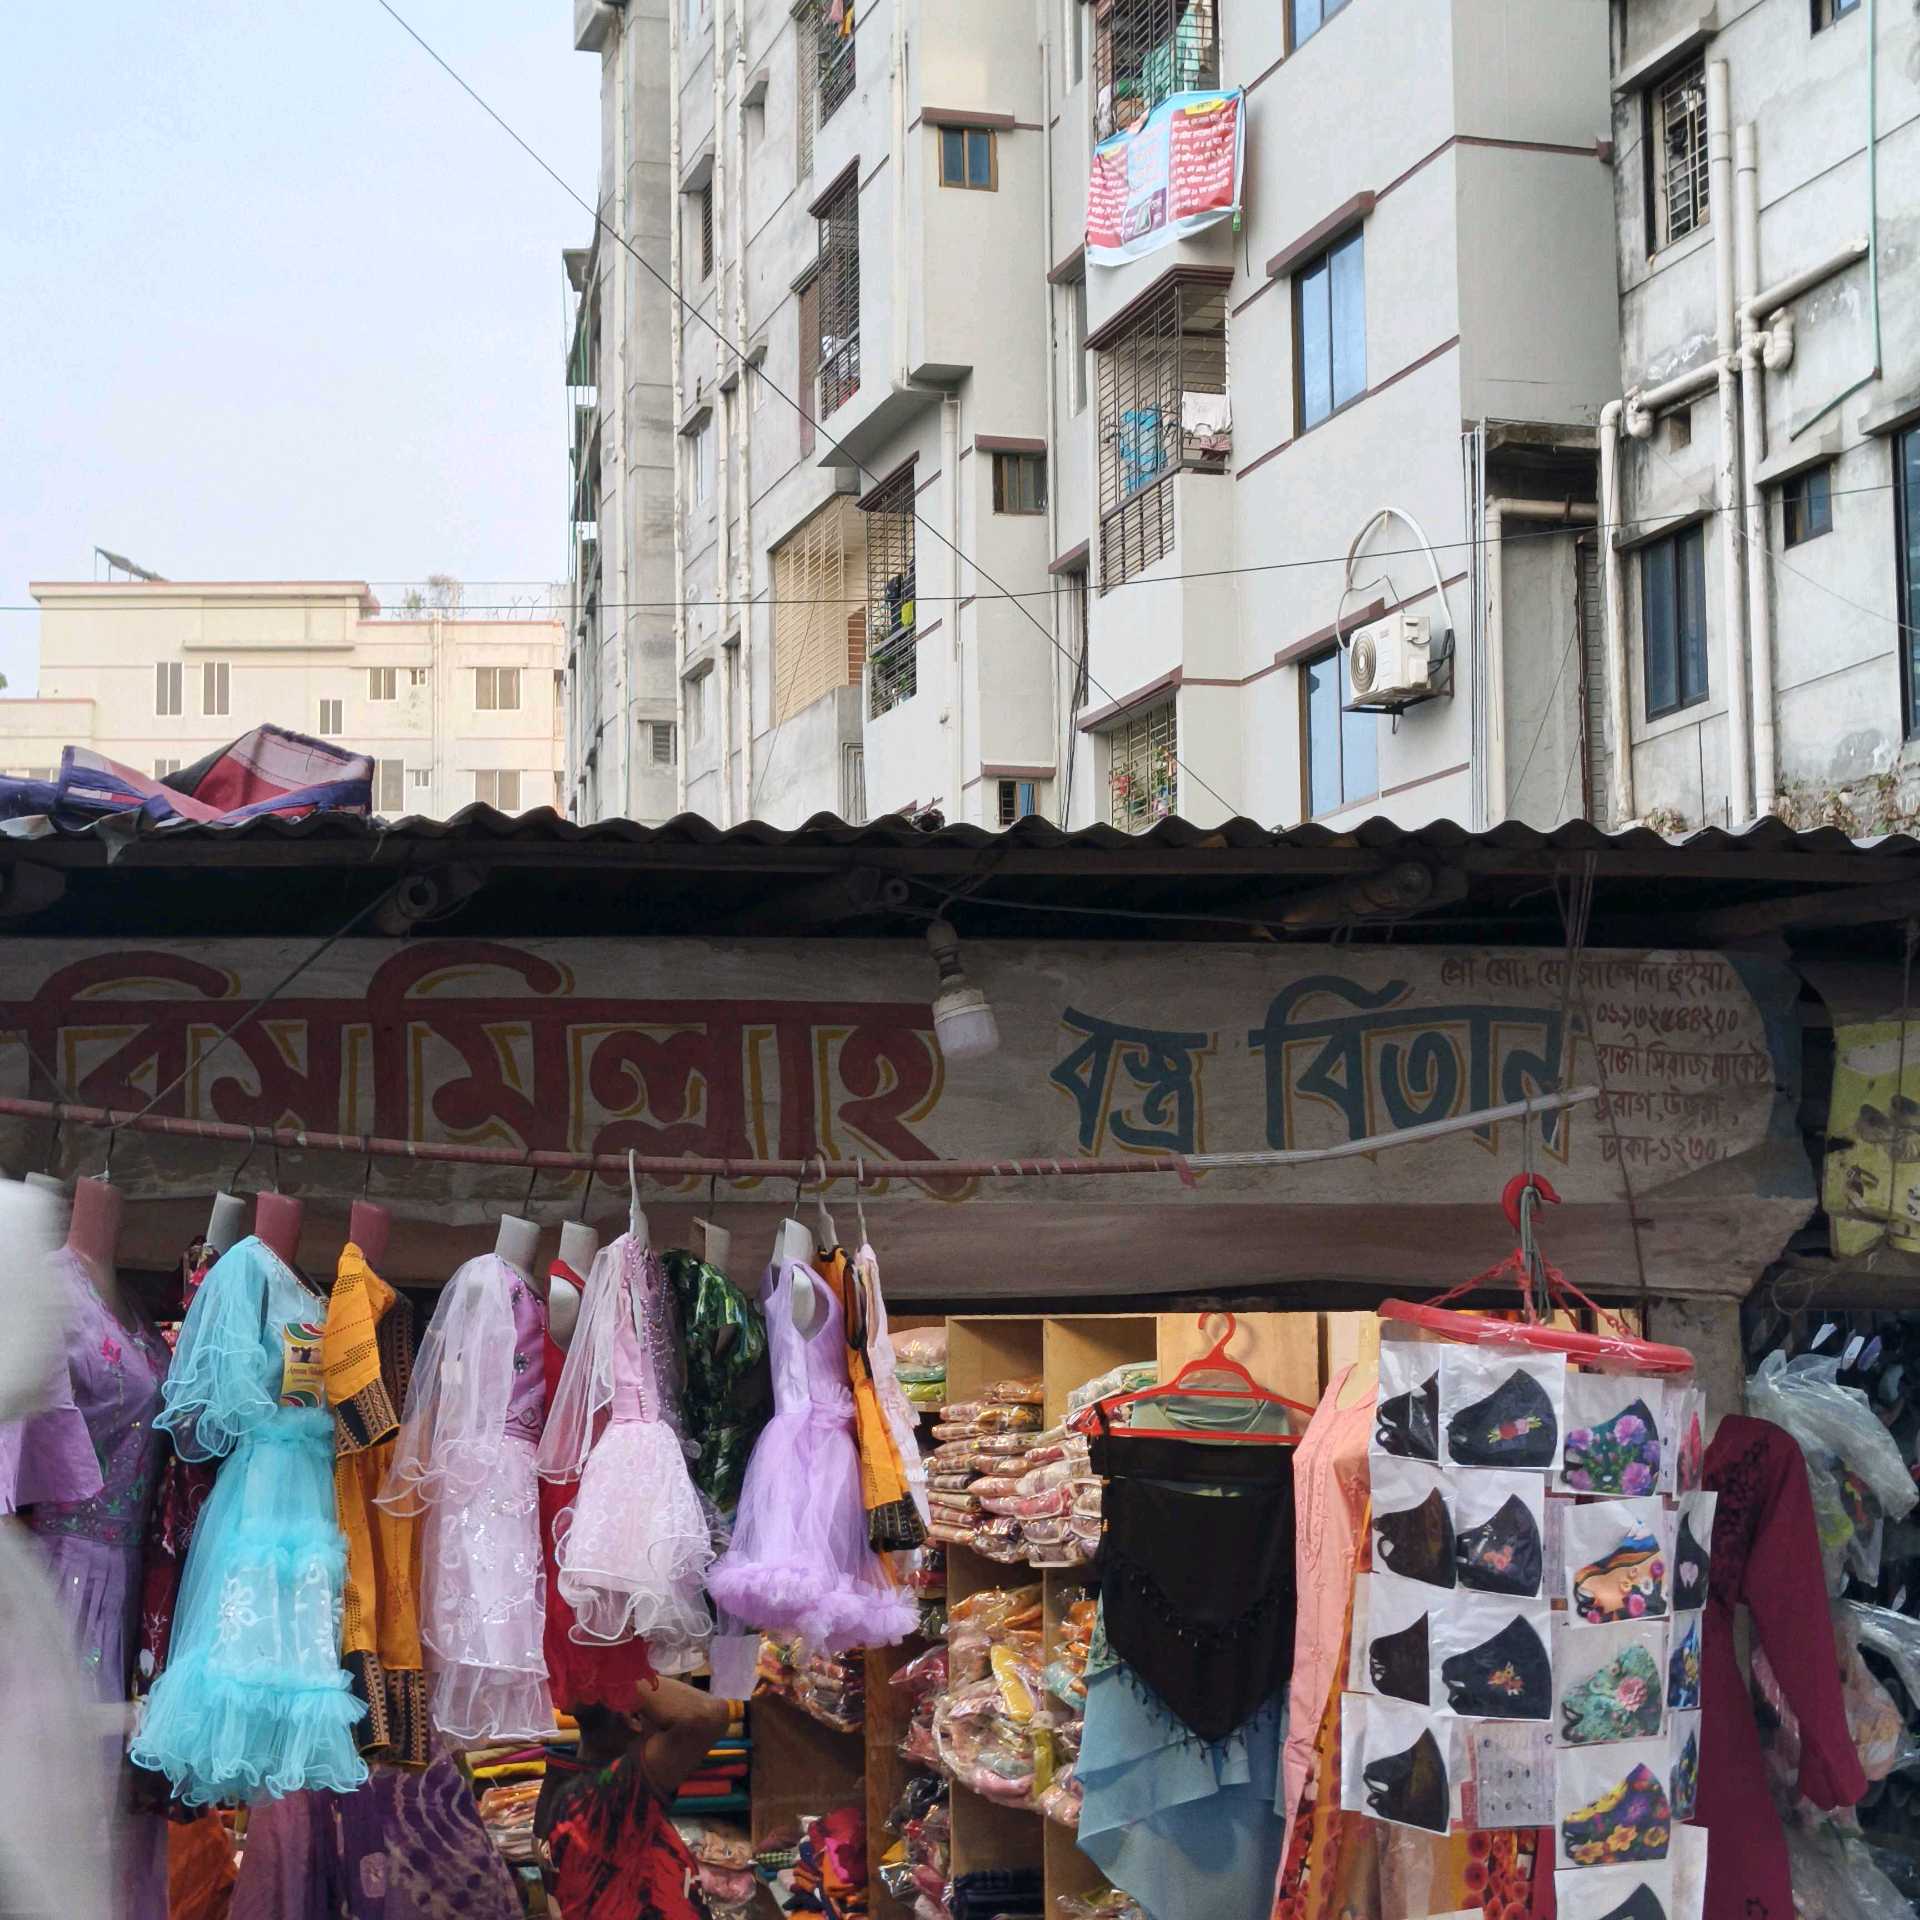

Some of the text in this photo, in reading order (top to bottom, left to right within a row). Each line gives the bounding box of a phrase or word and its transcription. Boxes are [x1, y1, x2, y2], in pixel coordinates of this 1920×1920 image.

[0, 938, 1585, 1203] বিসমিল্লাহ বস্ত্র বিতান
